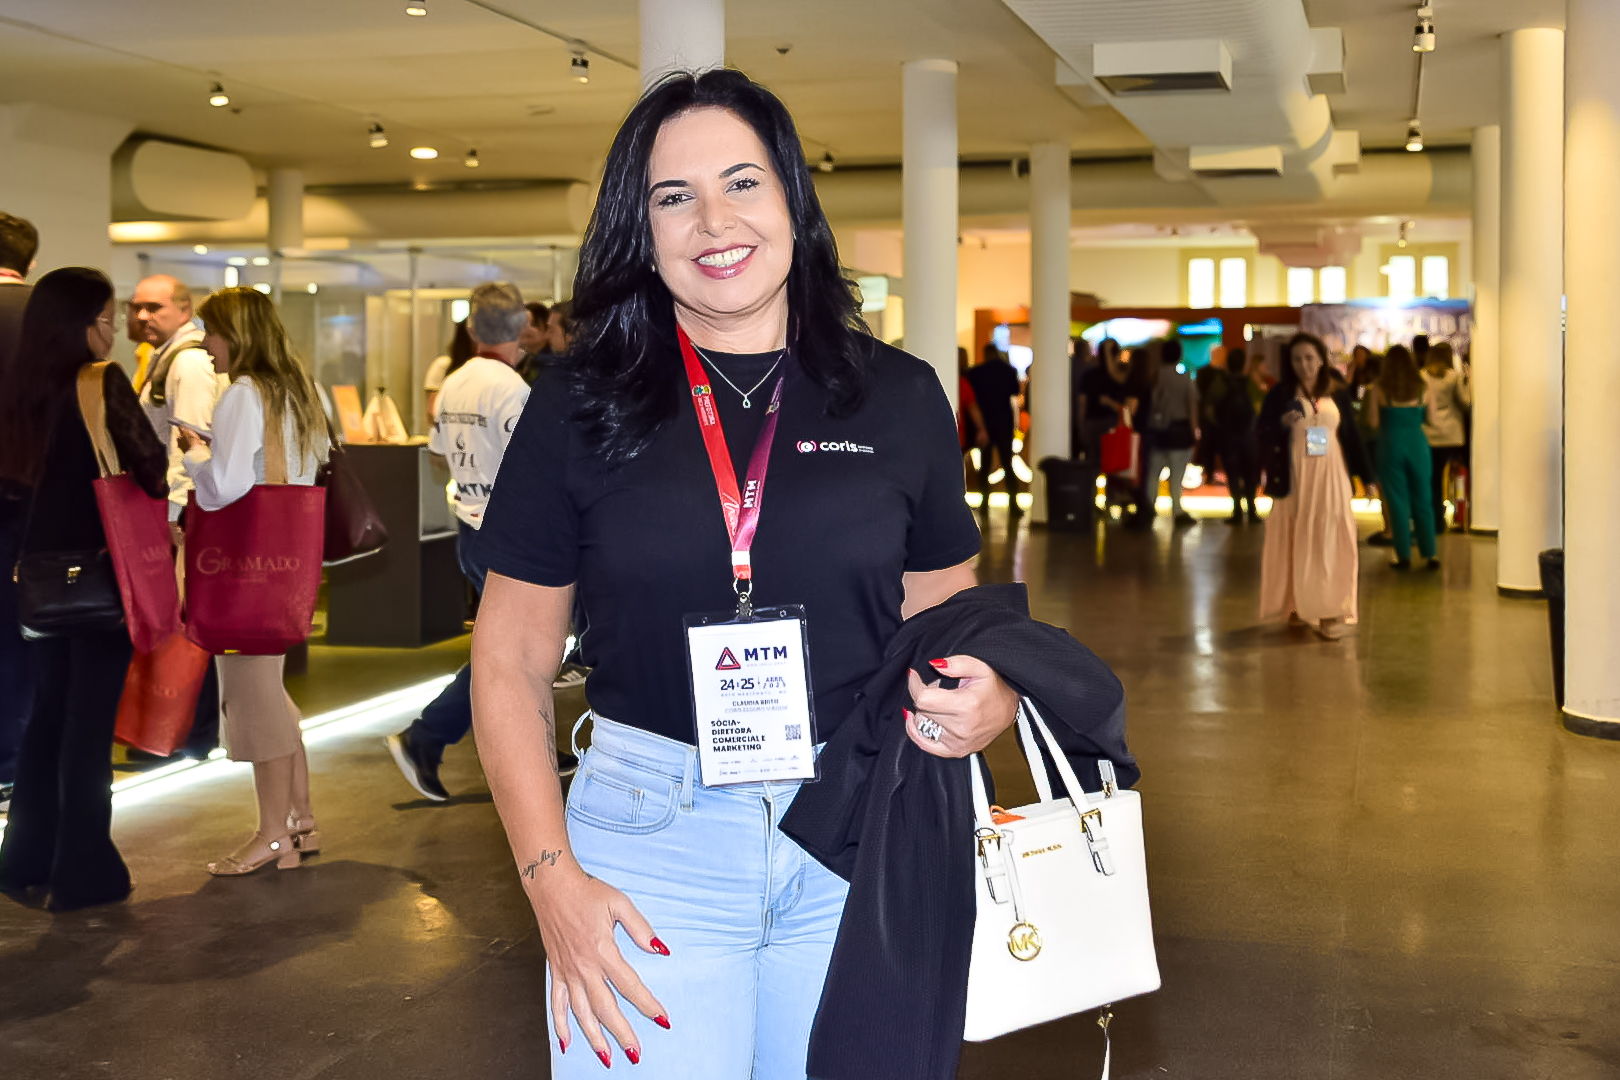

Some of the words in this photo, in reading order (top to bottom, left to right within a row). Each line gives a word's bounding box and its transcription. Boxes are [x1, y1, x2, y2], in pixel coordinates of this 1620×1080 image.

[820, 440, 859, 453] coris
[743, 480, 757, 508] MTM
[197, 547, 300, 575] GRAMADO
[744, 646, 787, 661] MTM
[720, 678, 735, 691] 24
[740, 677, 755, 690] 25
[711, 727, 752, 736] DIRETORA
[712, 735, 759, 745] COMERCIAL
[713, 743, 762, 753] MARKETING
